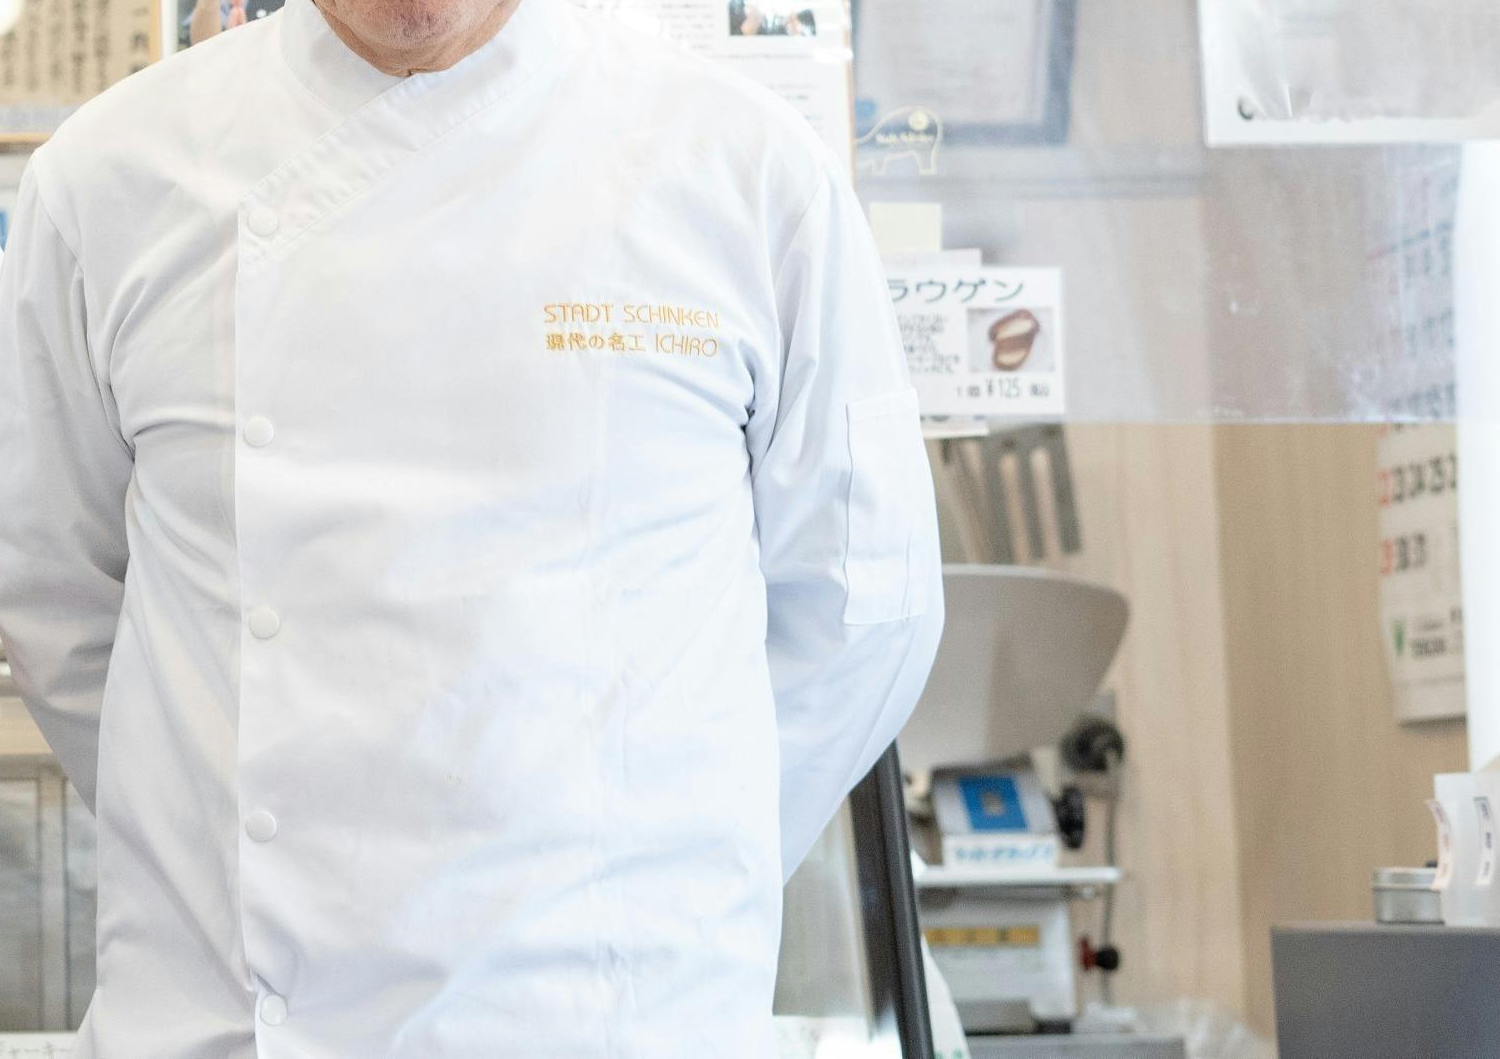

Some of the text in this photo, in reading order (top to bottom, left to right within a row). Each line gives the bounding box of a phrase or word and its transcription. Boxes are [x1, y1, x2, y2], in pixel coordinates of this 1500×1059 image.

[543, 301, 720, 330] STADT SCHINKEN
[655, 333, 718, 358] ICHIRO
